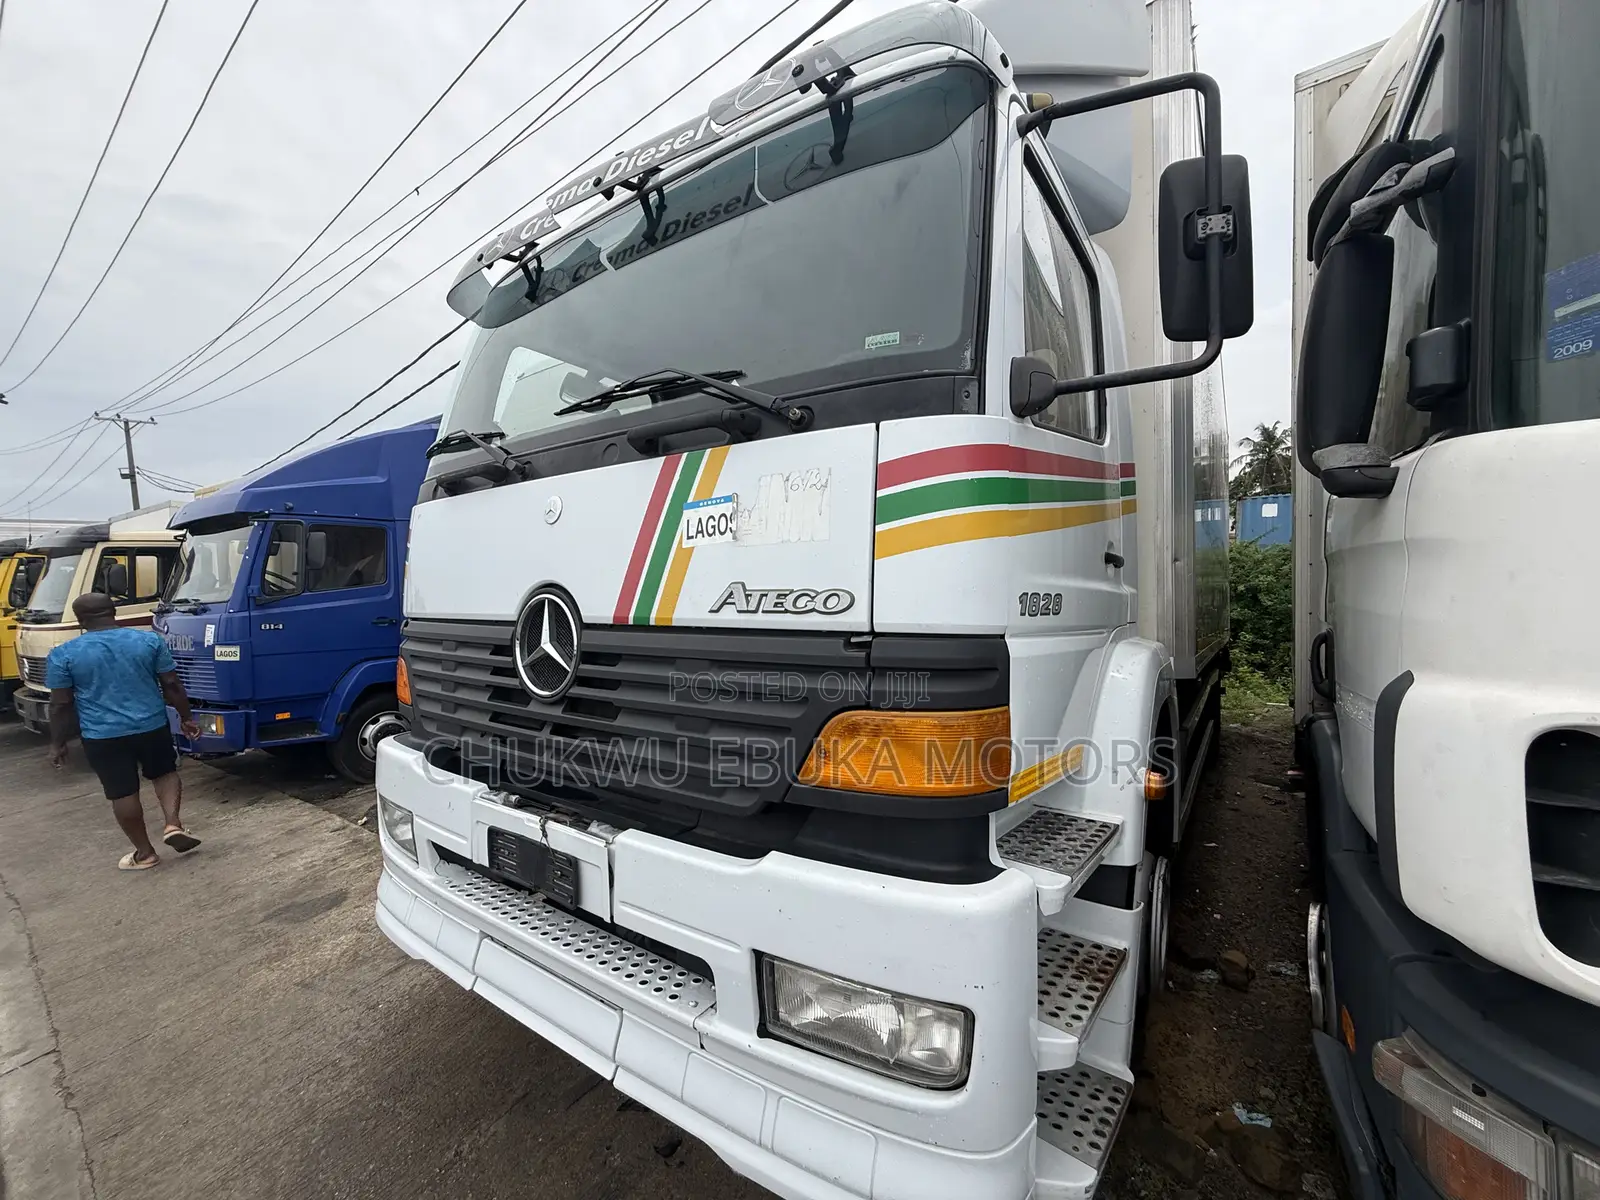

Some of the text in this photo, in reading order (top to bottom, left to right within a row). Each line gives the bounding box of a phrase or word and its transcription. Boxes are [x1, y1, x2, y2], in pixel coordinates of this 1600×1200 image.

[602, 116, 711, 183] Diesel
[659, 181, 755, 243] Diesel
[1553, 339, 1593, 359] 2009
[1018, 592, 1063, 617] 1828
[216, 650, 238, 658] LAGOS
